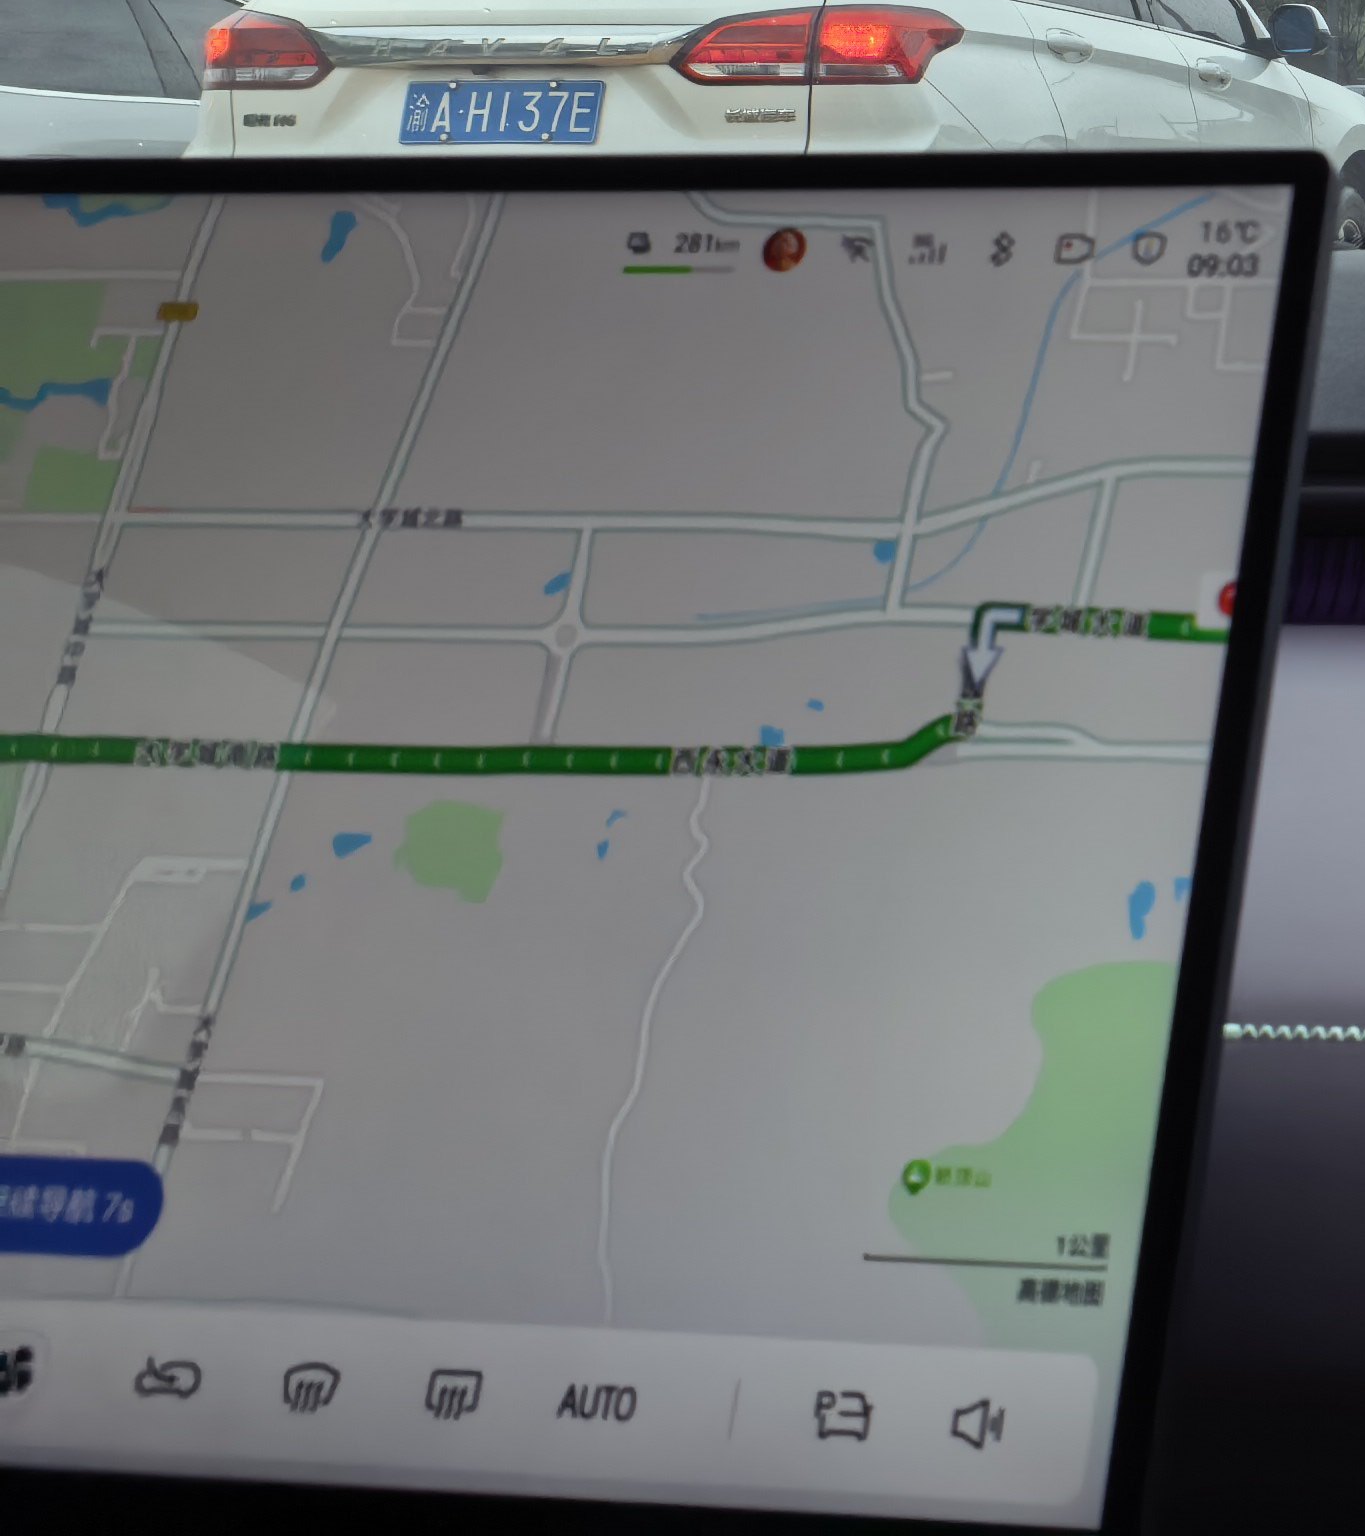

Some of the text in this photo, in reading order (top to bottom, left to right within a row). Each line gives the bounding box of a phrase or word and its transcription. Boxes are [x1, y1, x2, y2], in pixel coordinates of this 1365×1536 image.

[374, 37, 619, 58] HAVAL
[1187, 252, 1260, 278] 09:03
[556, 1382, 638, 1422] AUTO
